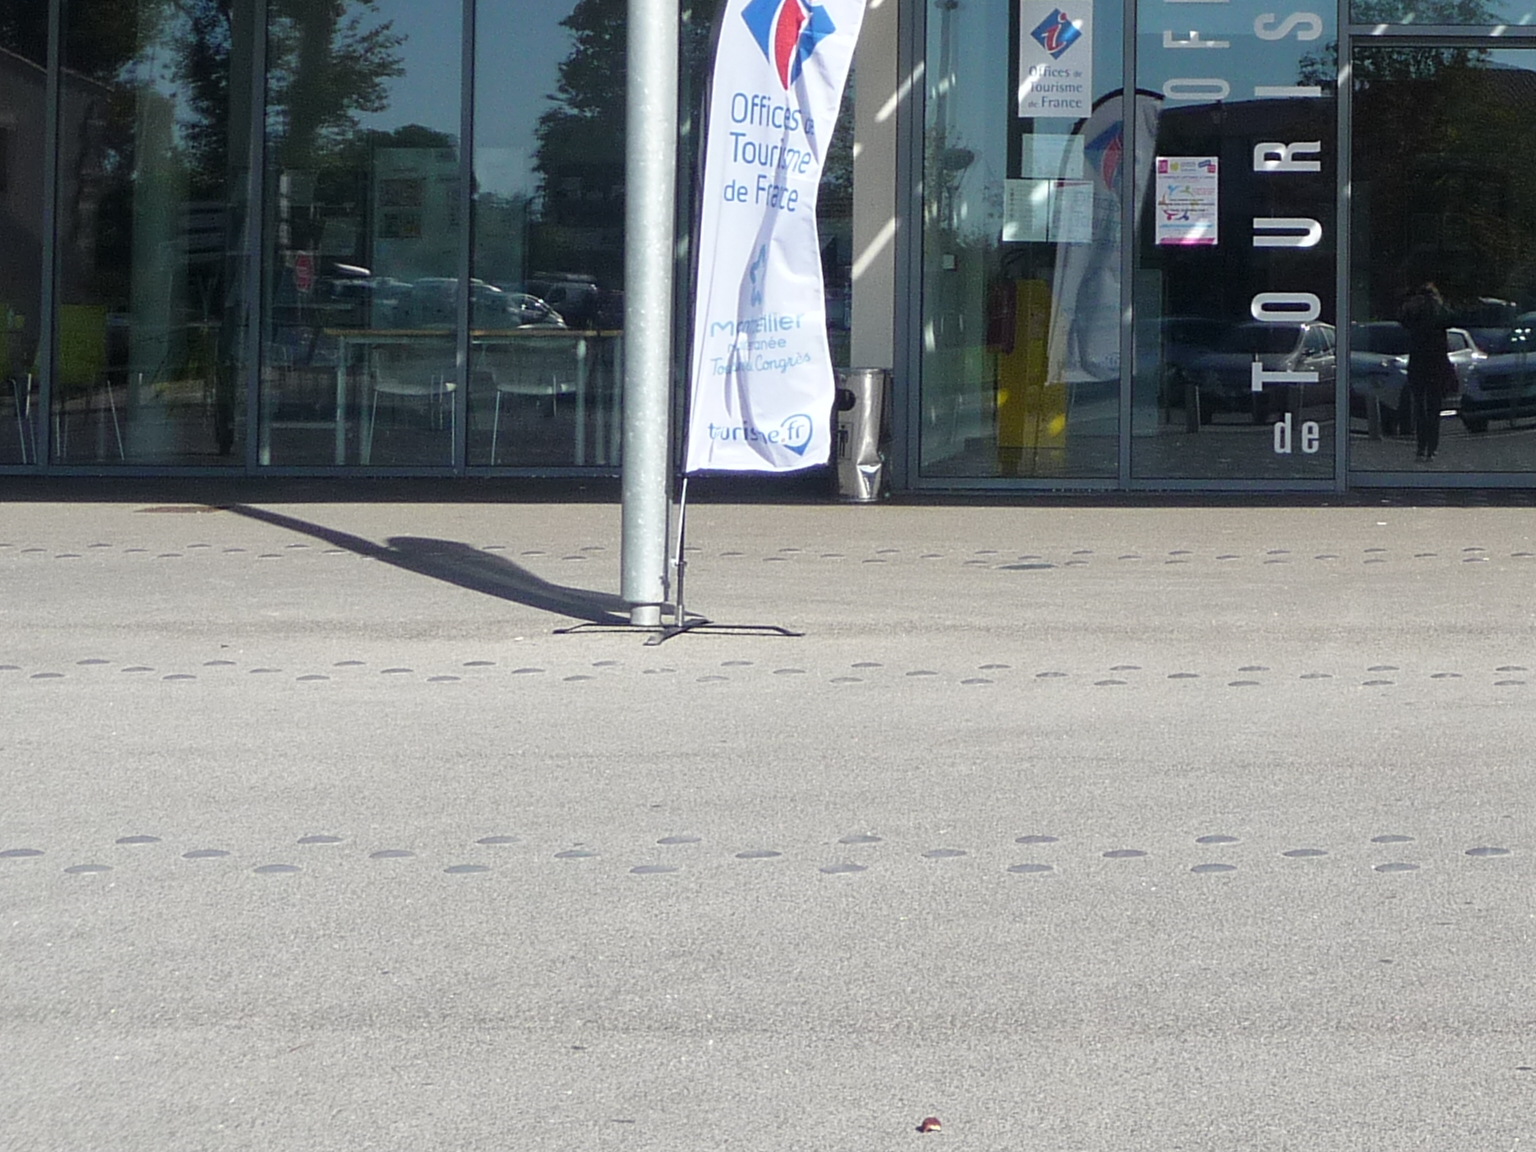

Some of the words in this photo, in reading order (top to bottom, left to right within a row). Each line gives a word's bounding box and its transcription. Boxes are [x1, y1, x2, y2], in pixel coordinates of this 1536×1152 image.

[1030, 81, 1083, 93] Tourisme
[1041, 95, 1082, 109] France
[731, 92, 801, 132] Offices
[723, 178, 748, 203] de
[755, 173, 799, 212] Frace
[1273, 412, 1320, 454] de
